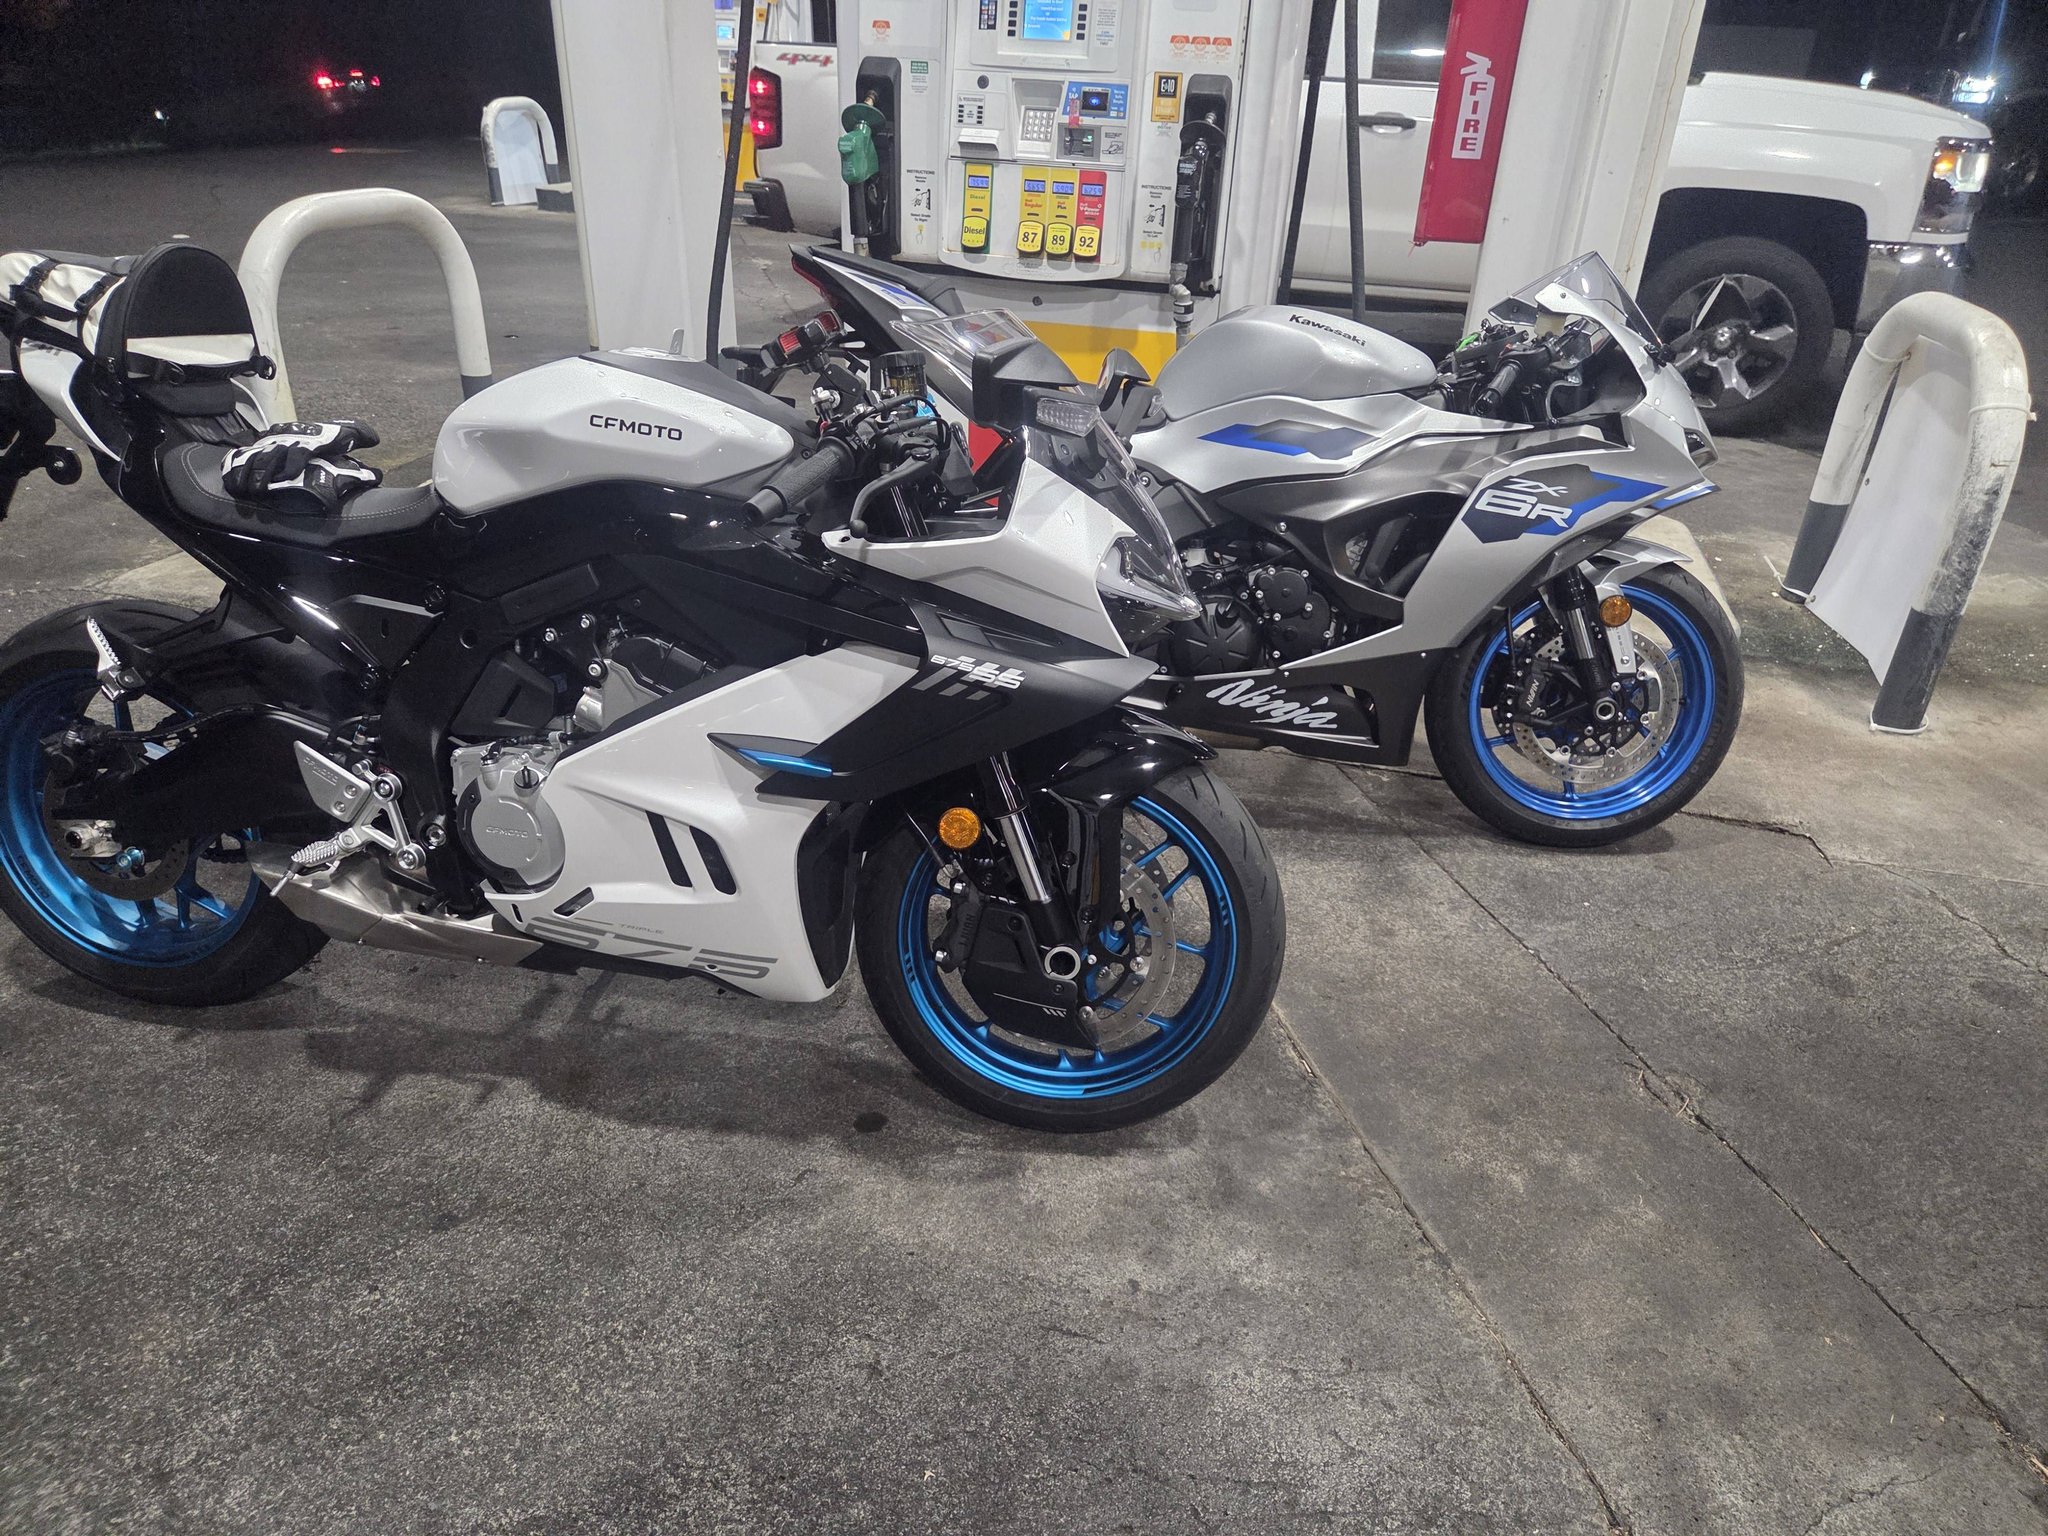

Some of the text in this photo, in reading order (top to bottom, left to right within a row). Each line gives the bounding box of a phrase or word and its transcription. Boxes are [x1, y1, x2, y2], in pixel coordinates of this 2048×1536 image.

[1459, 81, 1488, 151] FIRE
[963, 225, 985, 235] Diesel
[1022, 231, 1038, 243] 87
[1051, 234, 1066, 246] 89
[1079, 236, 1094, 248] 92
[1289, 314, 1366, 347] Kawasaki
[589, 414, 682, 441] CFMOTO
[1475, 489, 1573, 528] 6R
[1206, 678, 1338, 729] Ninja
[618, 923, 665, 935] TRIPLE
[524, 916, 778, 979] 675
